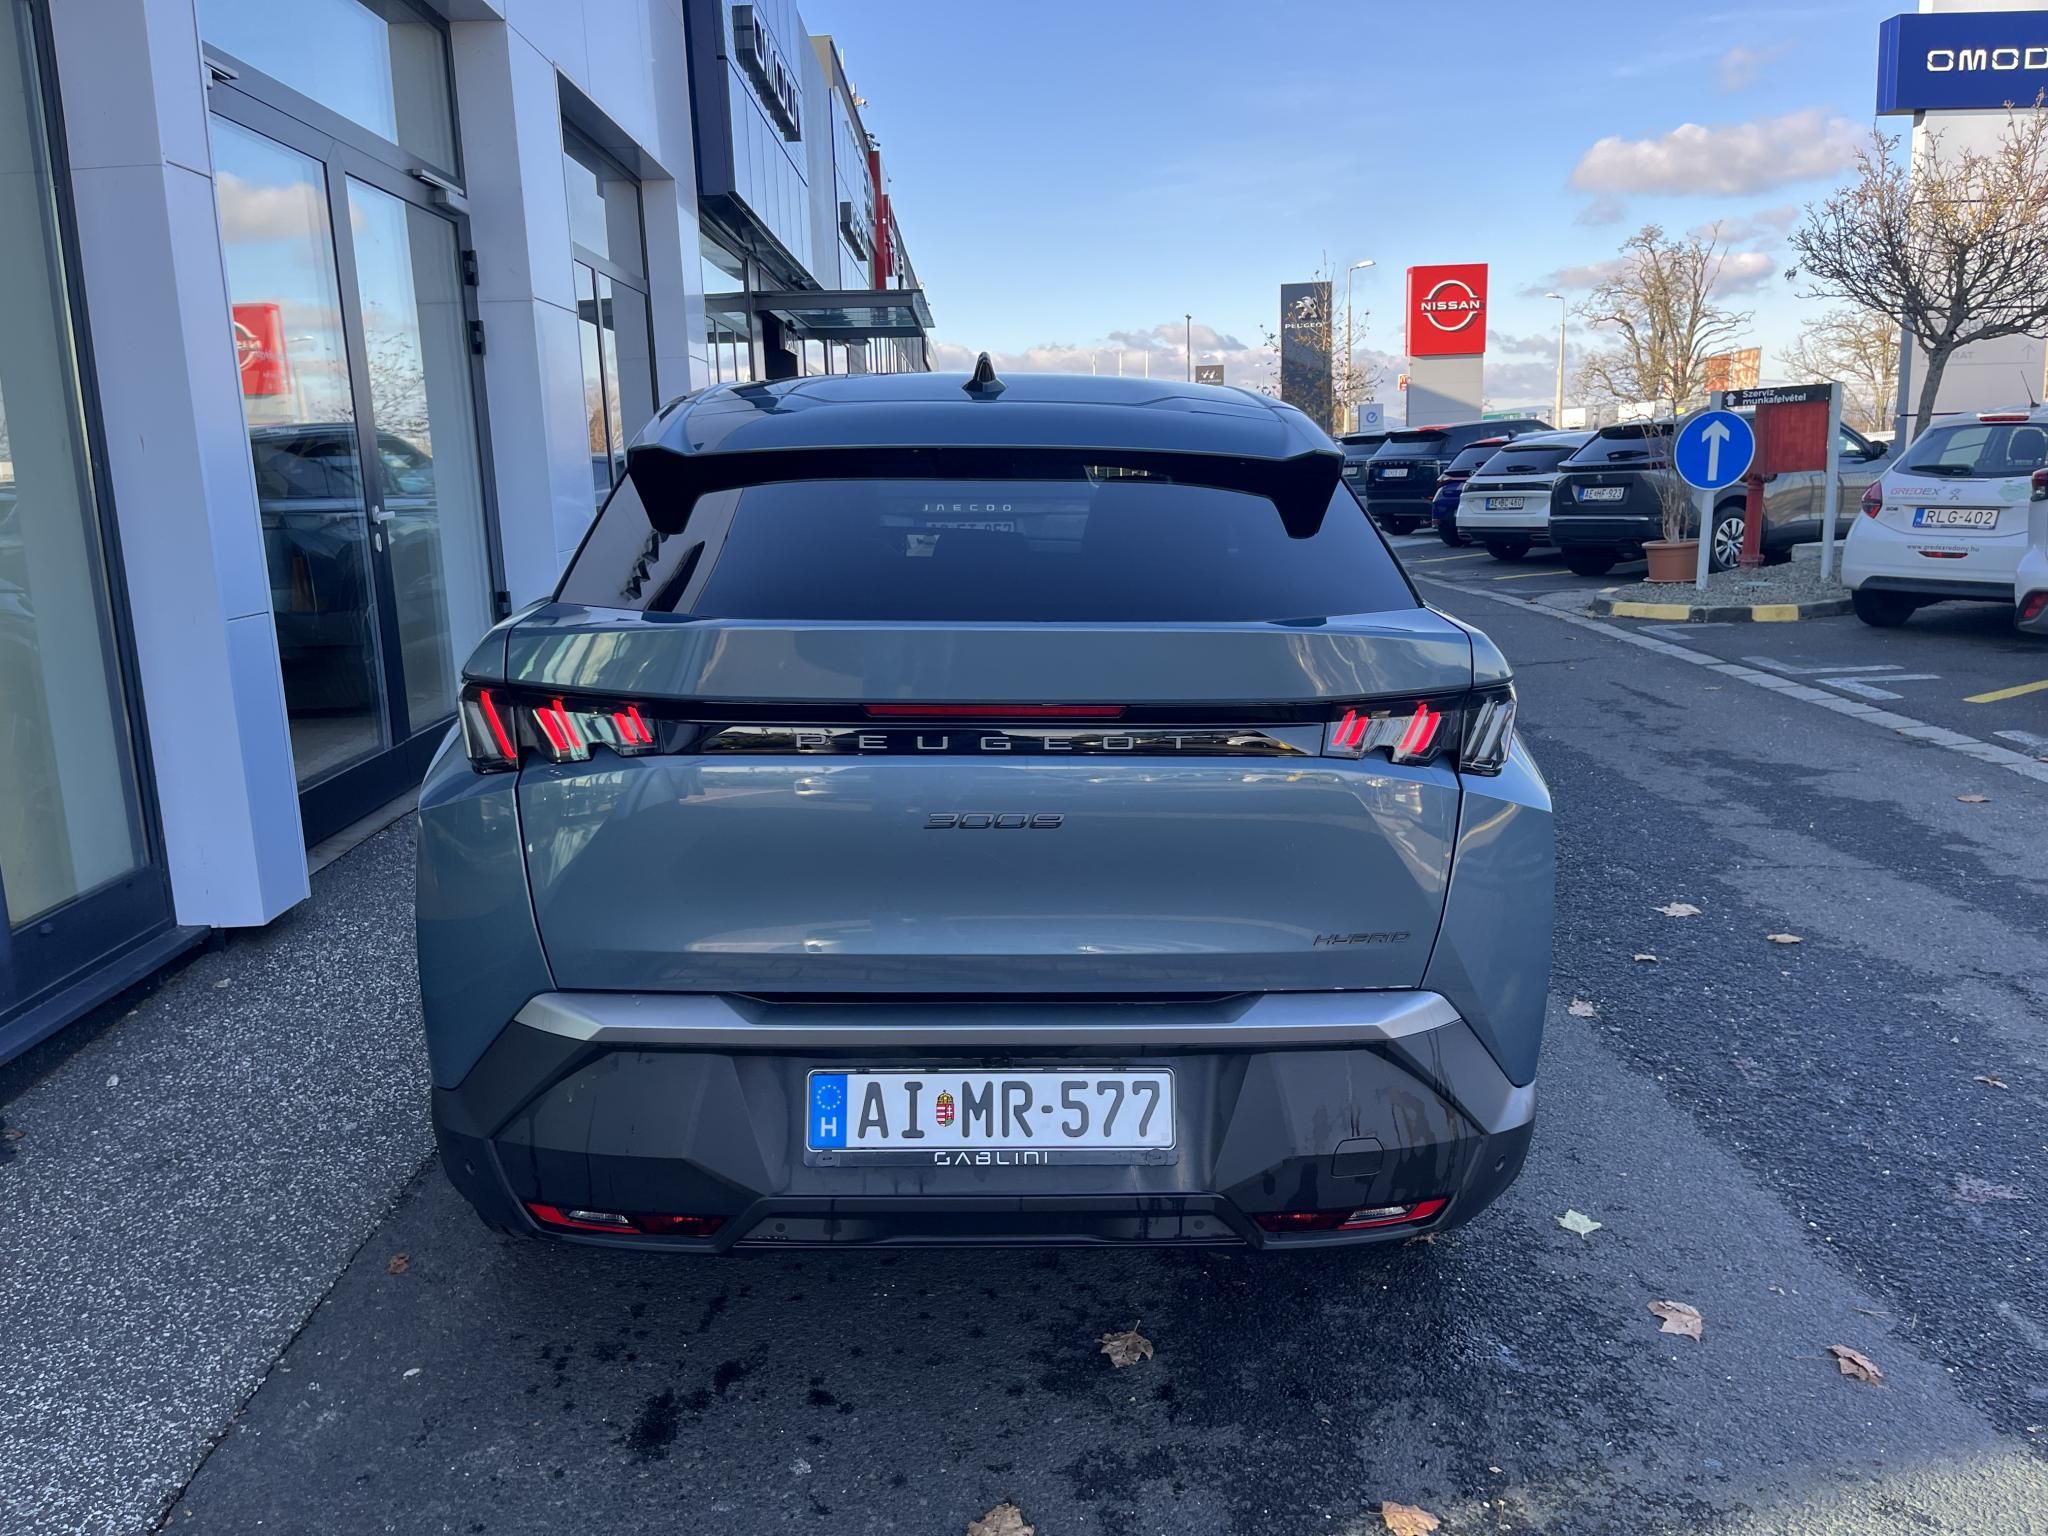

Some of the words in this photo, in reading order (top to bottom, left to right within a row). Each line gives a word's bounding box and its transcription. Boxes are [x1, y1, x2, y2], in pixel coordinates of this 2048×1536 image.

[1927, 47, 2048, 71] OMOD
[1421, 300, 1480, 311] NISSAN
[1742, 389, 1775, 398] Szerviz
[1742, 394, 1807, 405] munkafelvétel
[1925, 510, 1993, 525] RLG-402
[796, 733, 1188, 751] PEUGEOT
[923, 812, 1065, 830] 3008
[820, 1117, 838, 1138] H
[934, 1151, 1049, 1166] GABLINI
